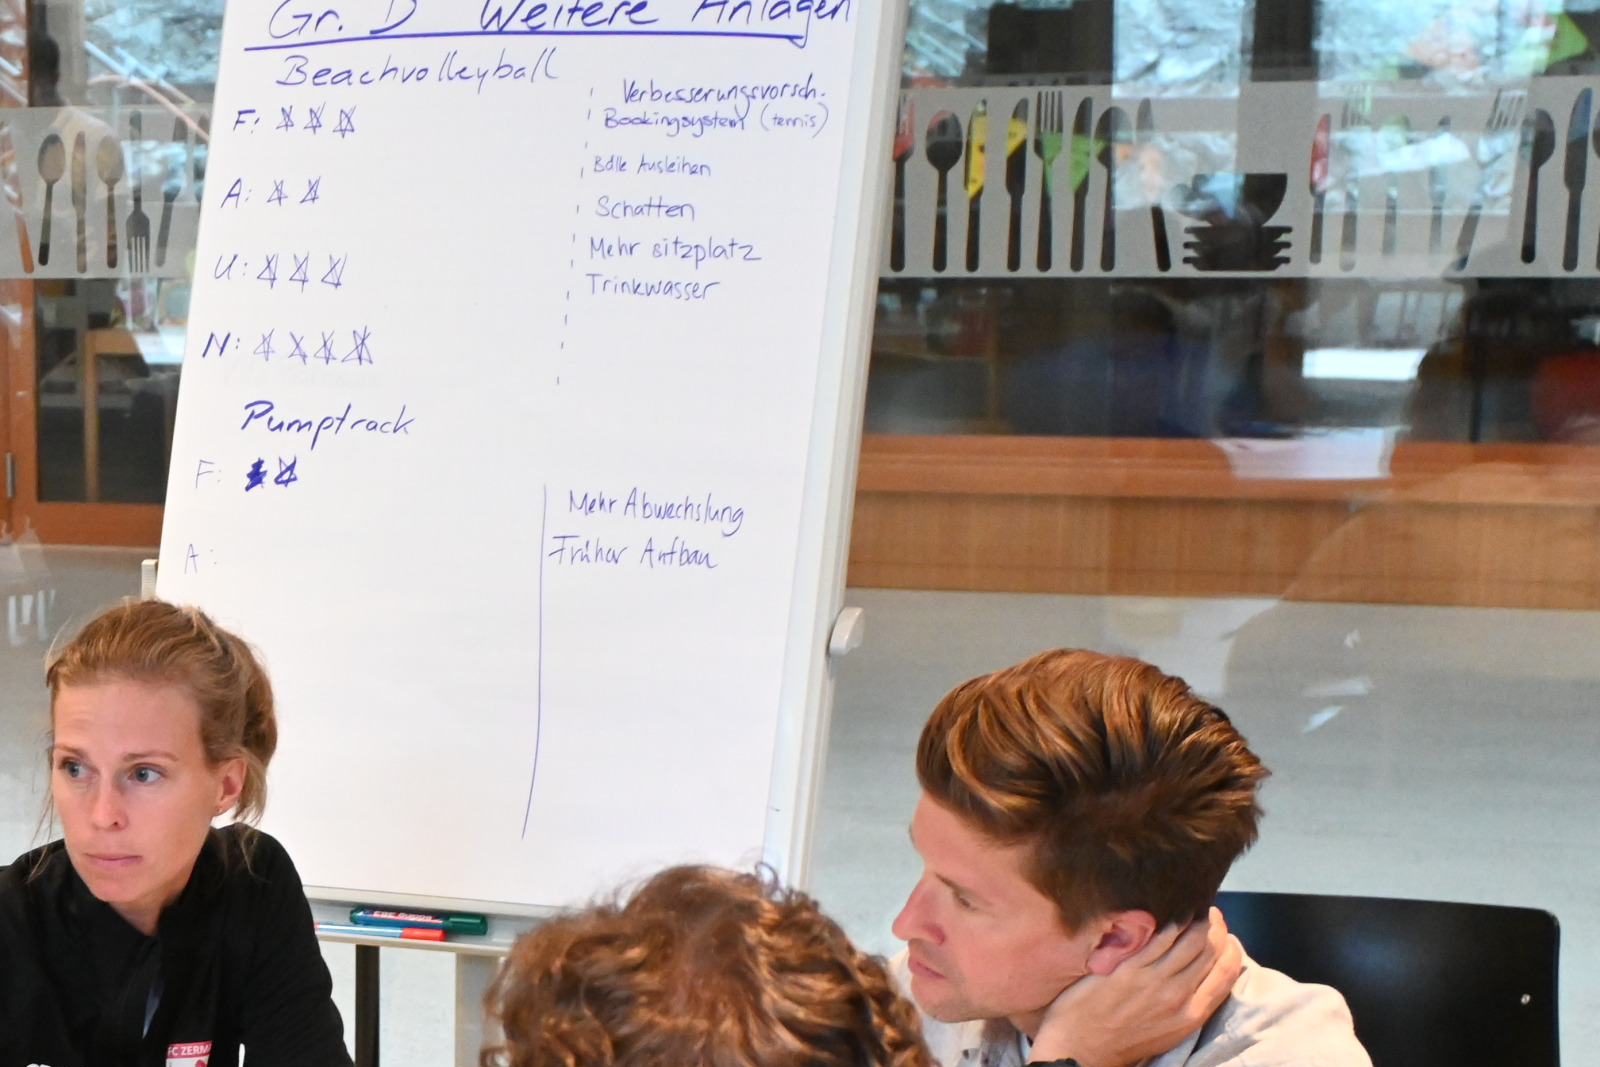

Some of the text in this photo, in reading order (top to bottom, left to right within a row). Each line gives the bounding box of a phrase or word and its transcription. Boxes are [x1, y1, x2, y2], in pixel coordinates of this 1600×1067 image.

[269, 0, 850, 49] Gr. D Weitere Anlagen
[276, 47, 558, 95] Beachvolleyball
[595, 195, 695, 222] Schatten
[590, 236, 641, 260] Mehr
[585, 273, 721, 301] Trinkwasser
[241, 399, 416, 451] Pumptrack
[569, 486, 744, 537] Mehr Abwechslung
